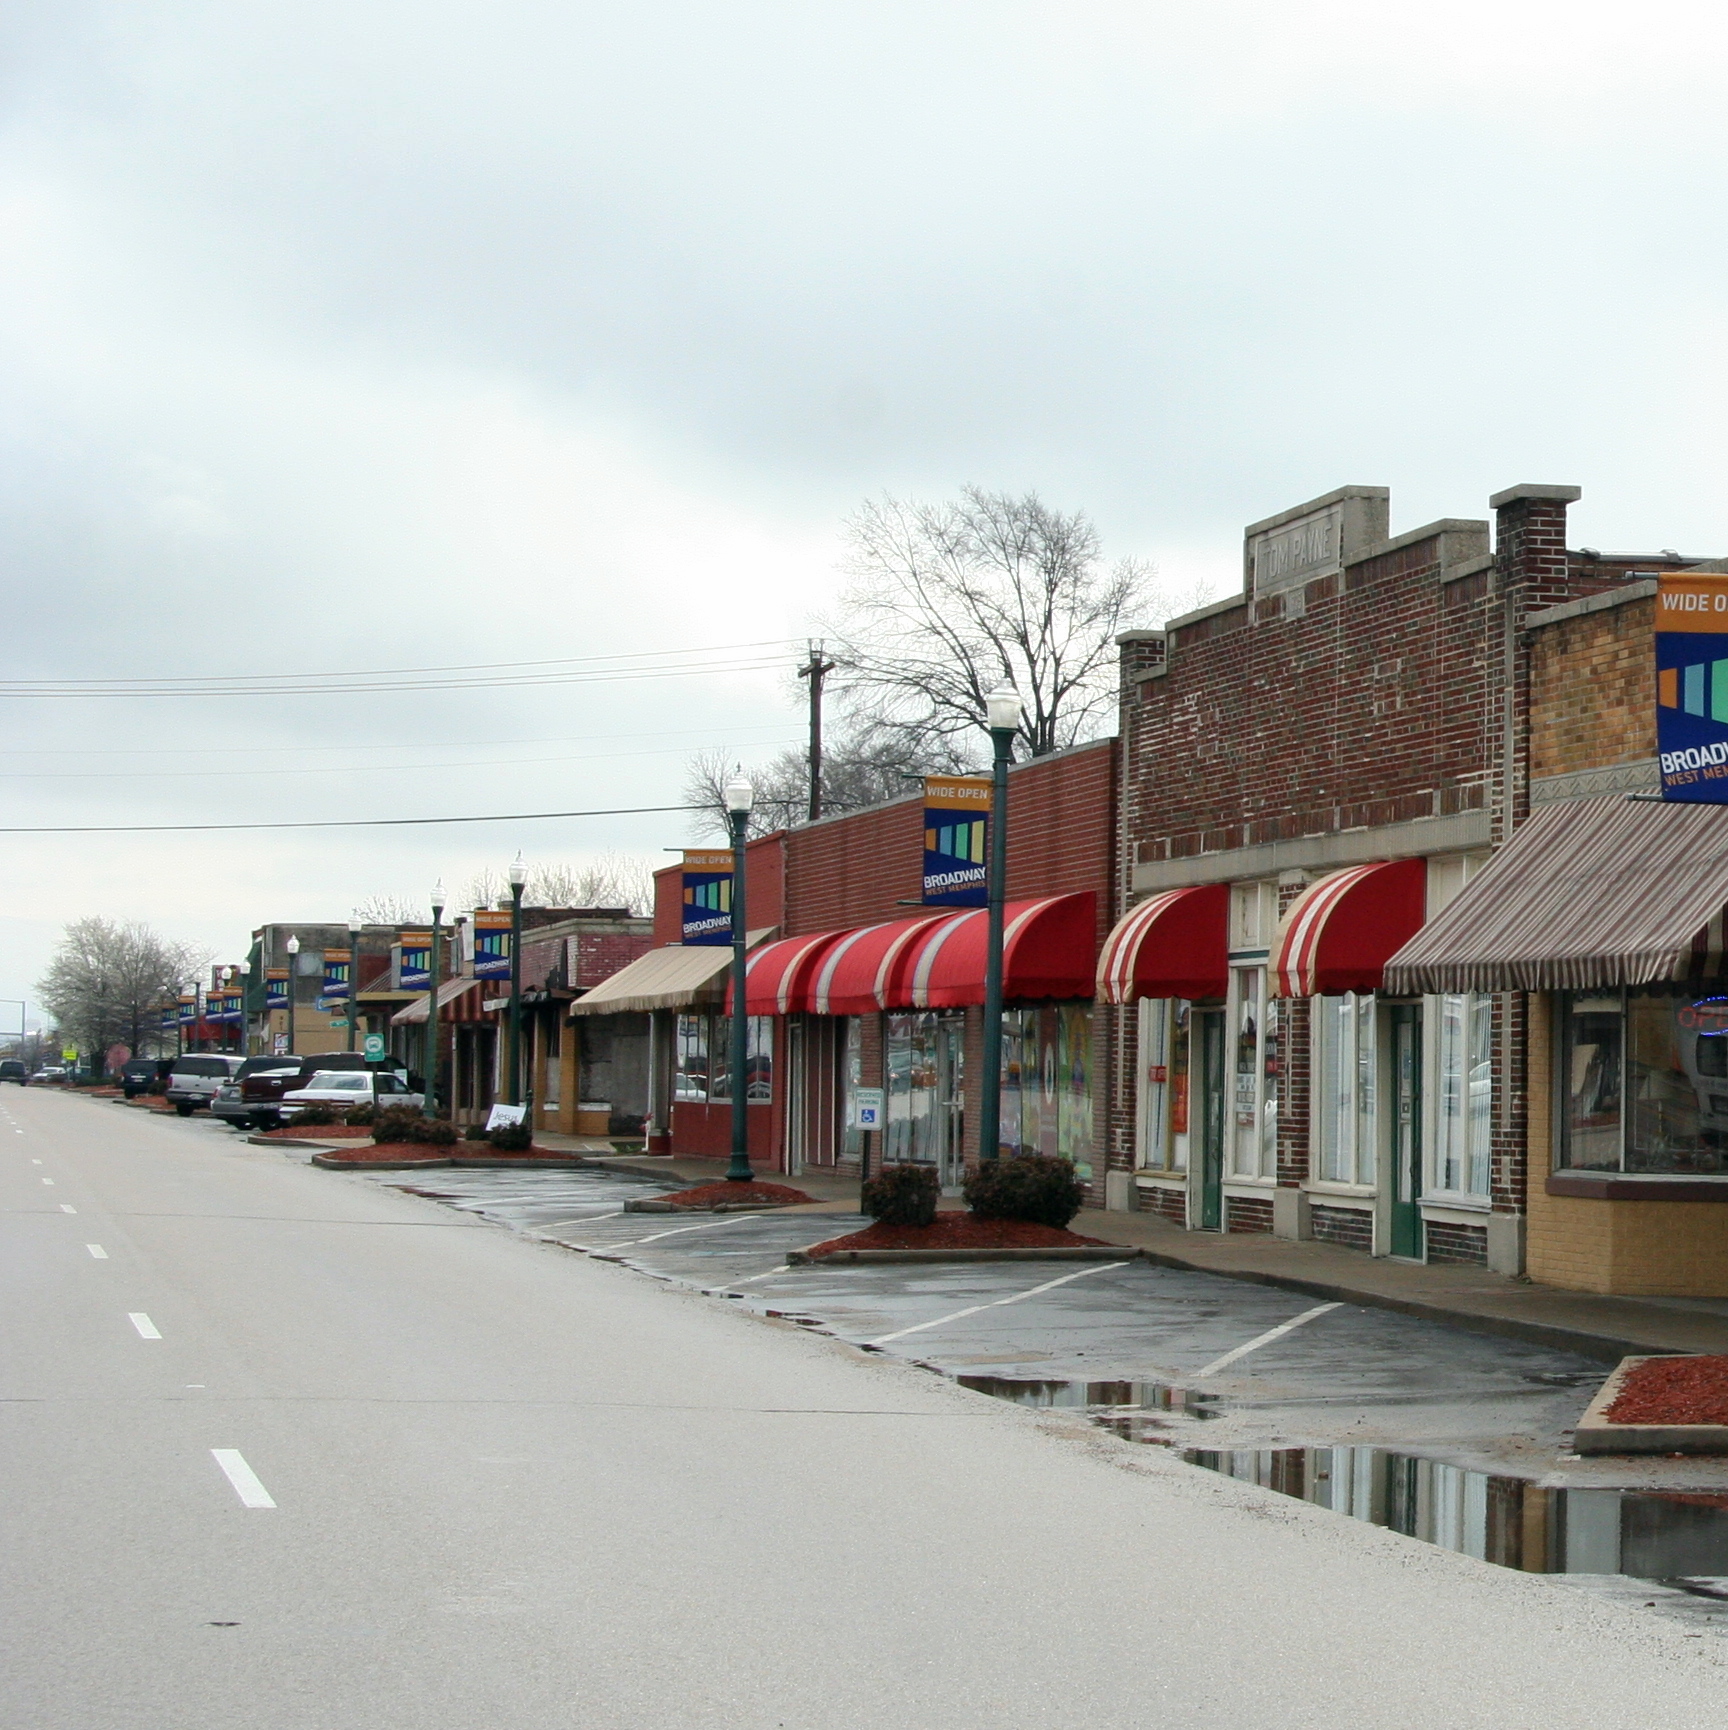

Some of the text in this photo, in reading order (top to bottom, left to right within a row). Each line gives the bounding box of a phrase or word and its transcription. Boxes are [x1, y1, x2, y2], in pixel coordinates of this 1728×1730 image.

[1264, 524, 1332, 581] TOM PAYNE
[1662, 593, 1709, 611] WIDE
[1665, 769, 1699, 786] WEST
[927, 786, 988, 799] WIDE OPEN
[924, 867, 987, 889] BROADWAY
[925, 880, 986, 896] WEST MEMPHIS
[683, 915, 732, 934] BROADWAY
